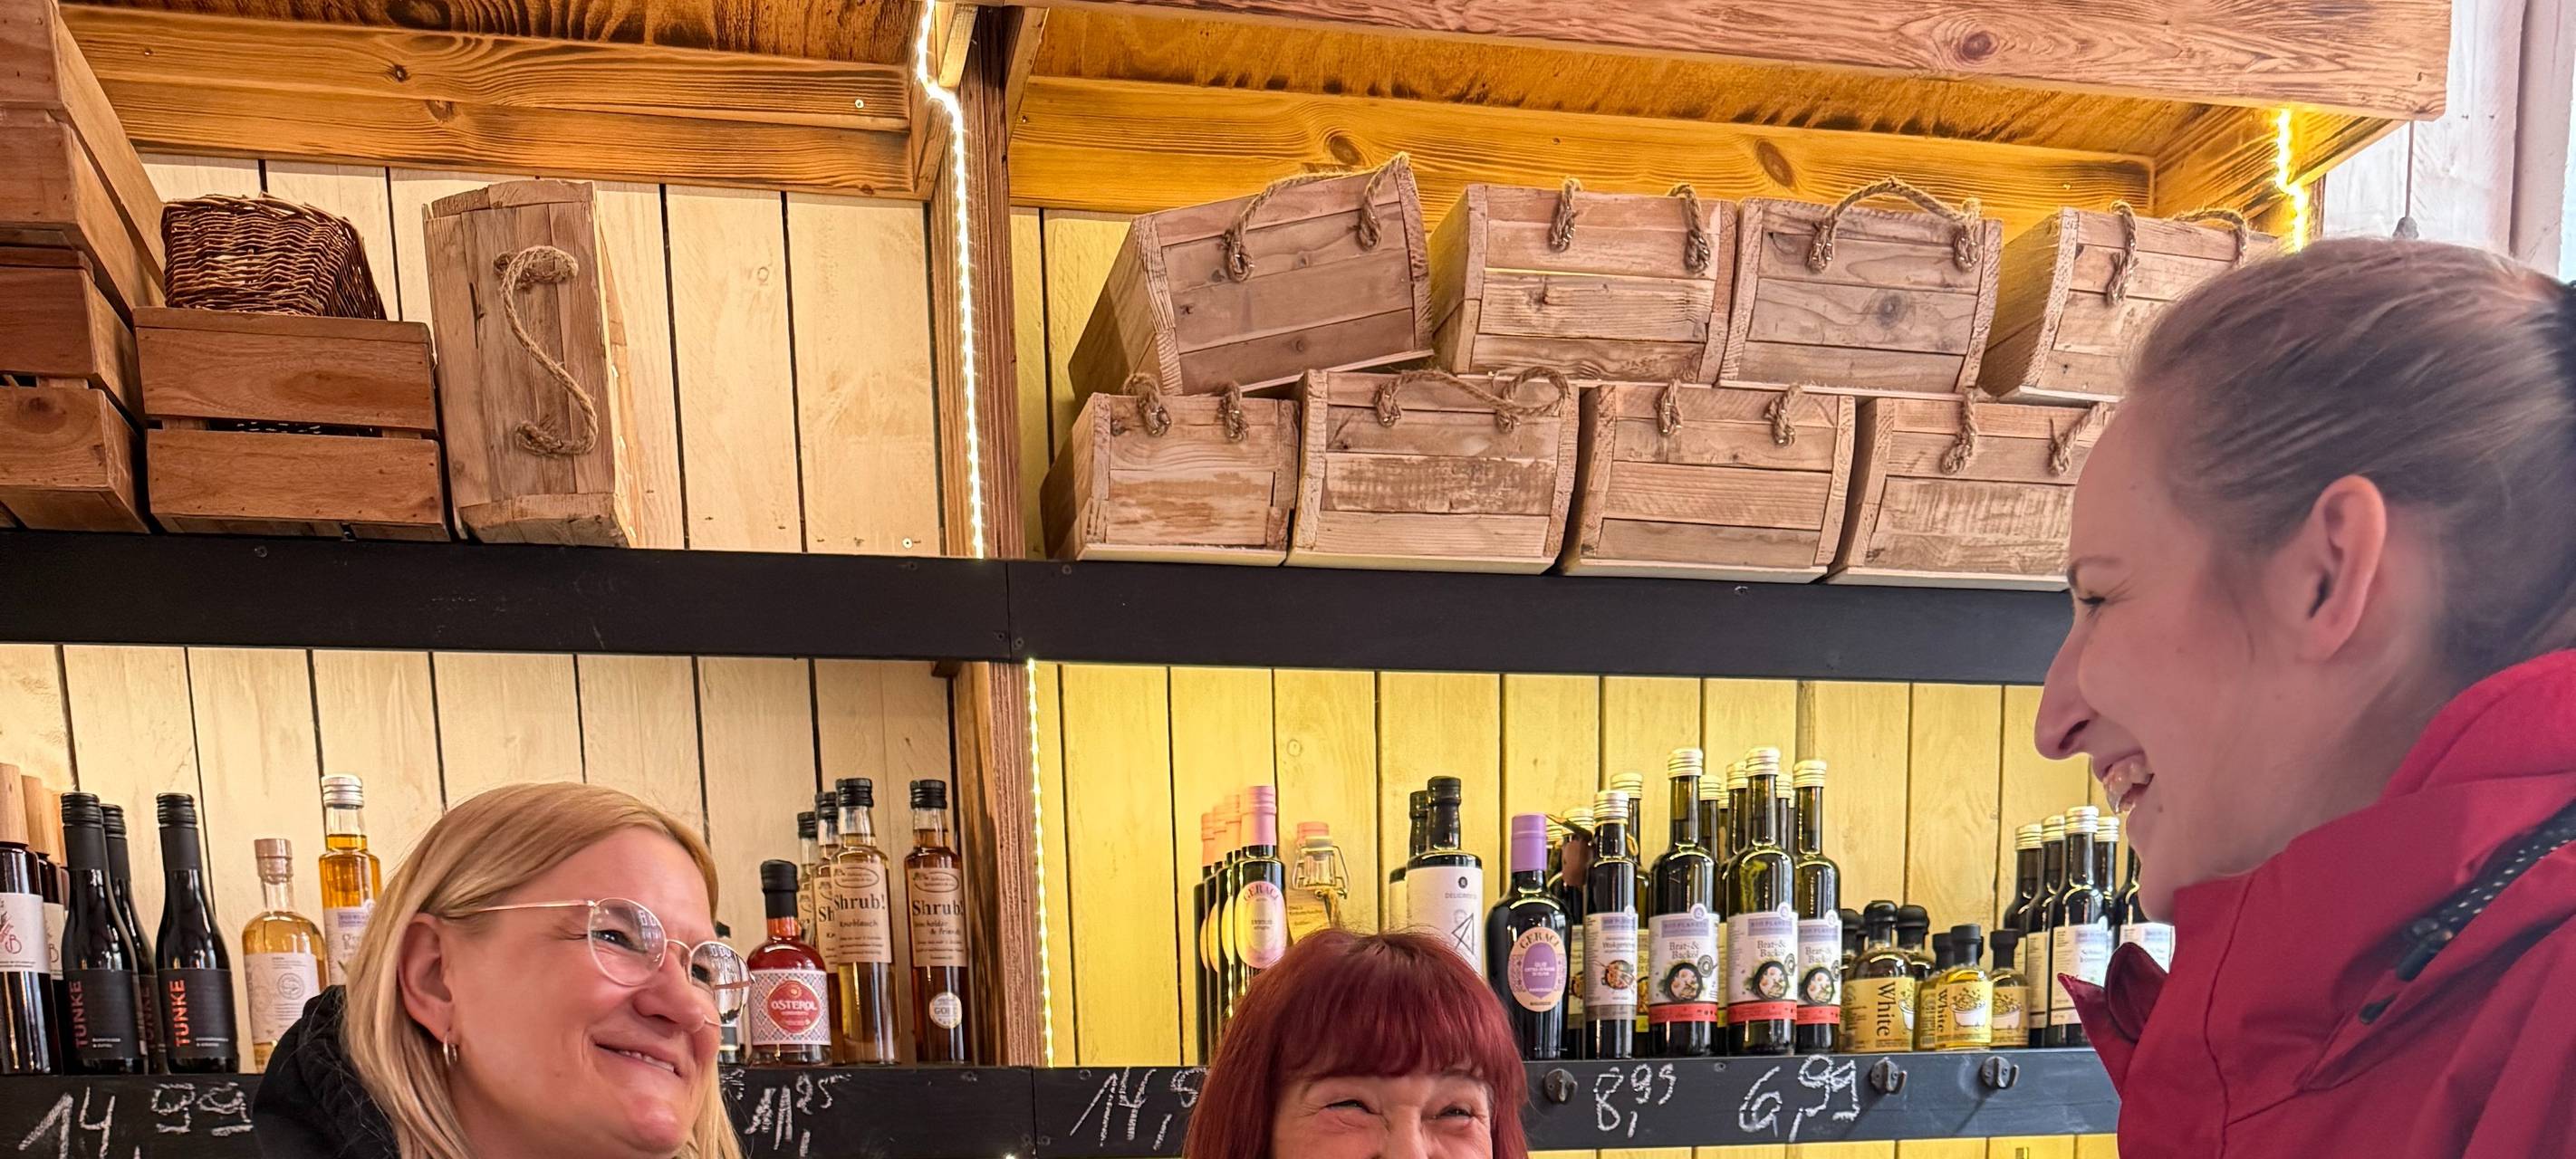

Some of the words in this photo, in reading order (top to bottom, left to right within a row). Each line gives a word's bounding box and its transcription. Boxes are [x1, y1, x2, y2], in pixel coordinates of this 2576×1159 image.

[833, 894, 886, 911] Shrub!
[912, 900, 964, 915] Shrub!
[69, 982, 88, 1048] TUNKE
[169, 980, 190, 1047] TUNKE
[771, 1000, 817, 1011] OSTEROL
[1877, 982, 1896, 1036] White
[1937, 988, 1947, 1032] White
